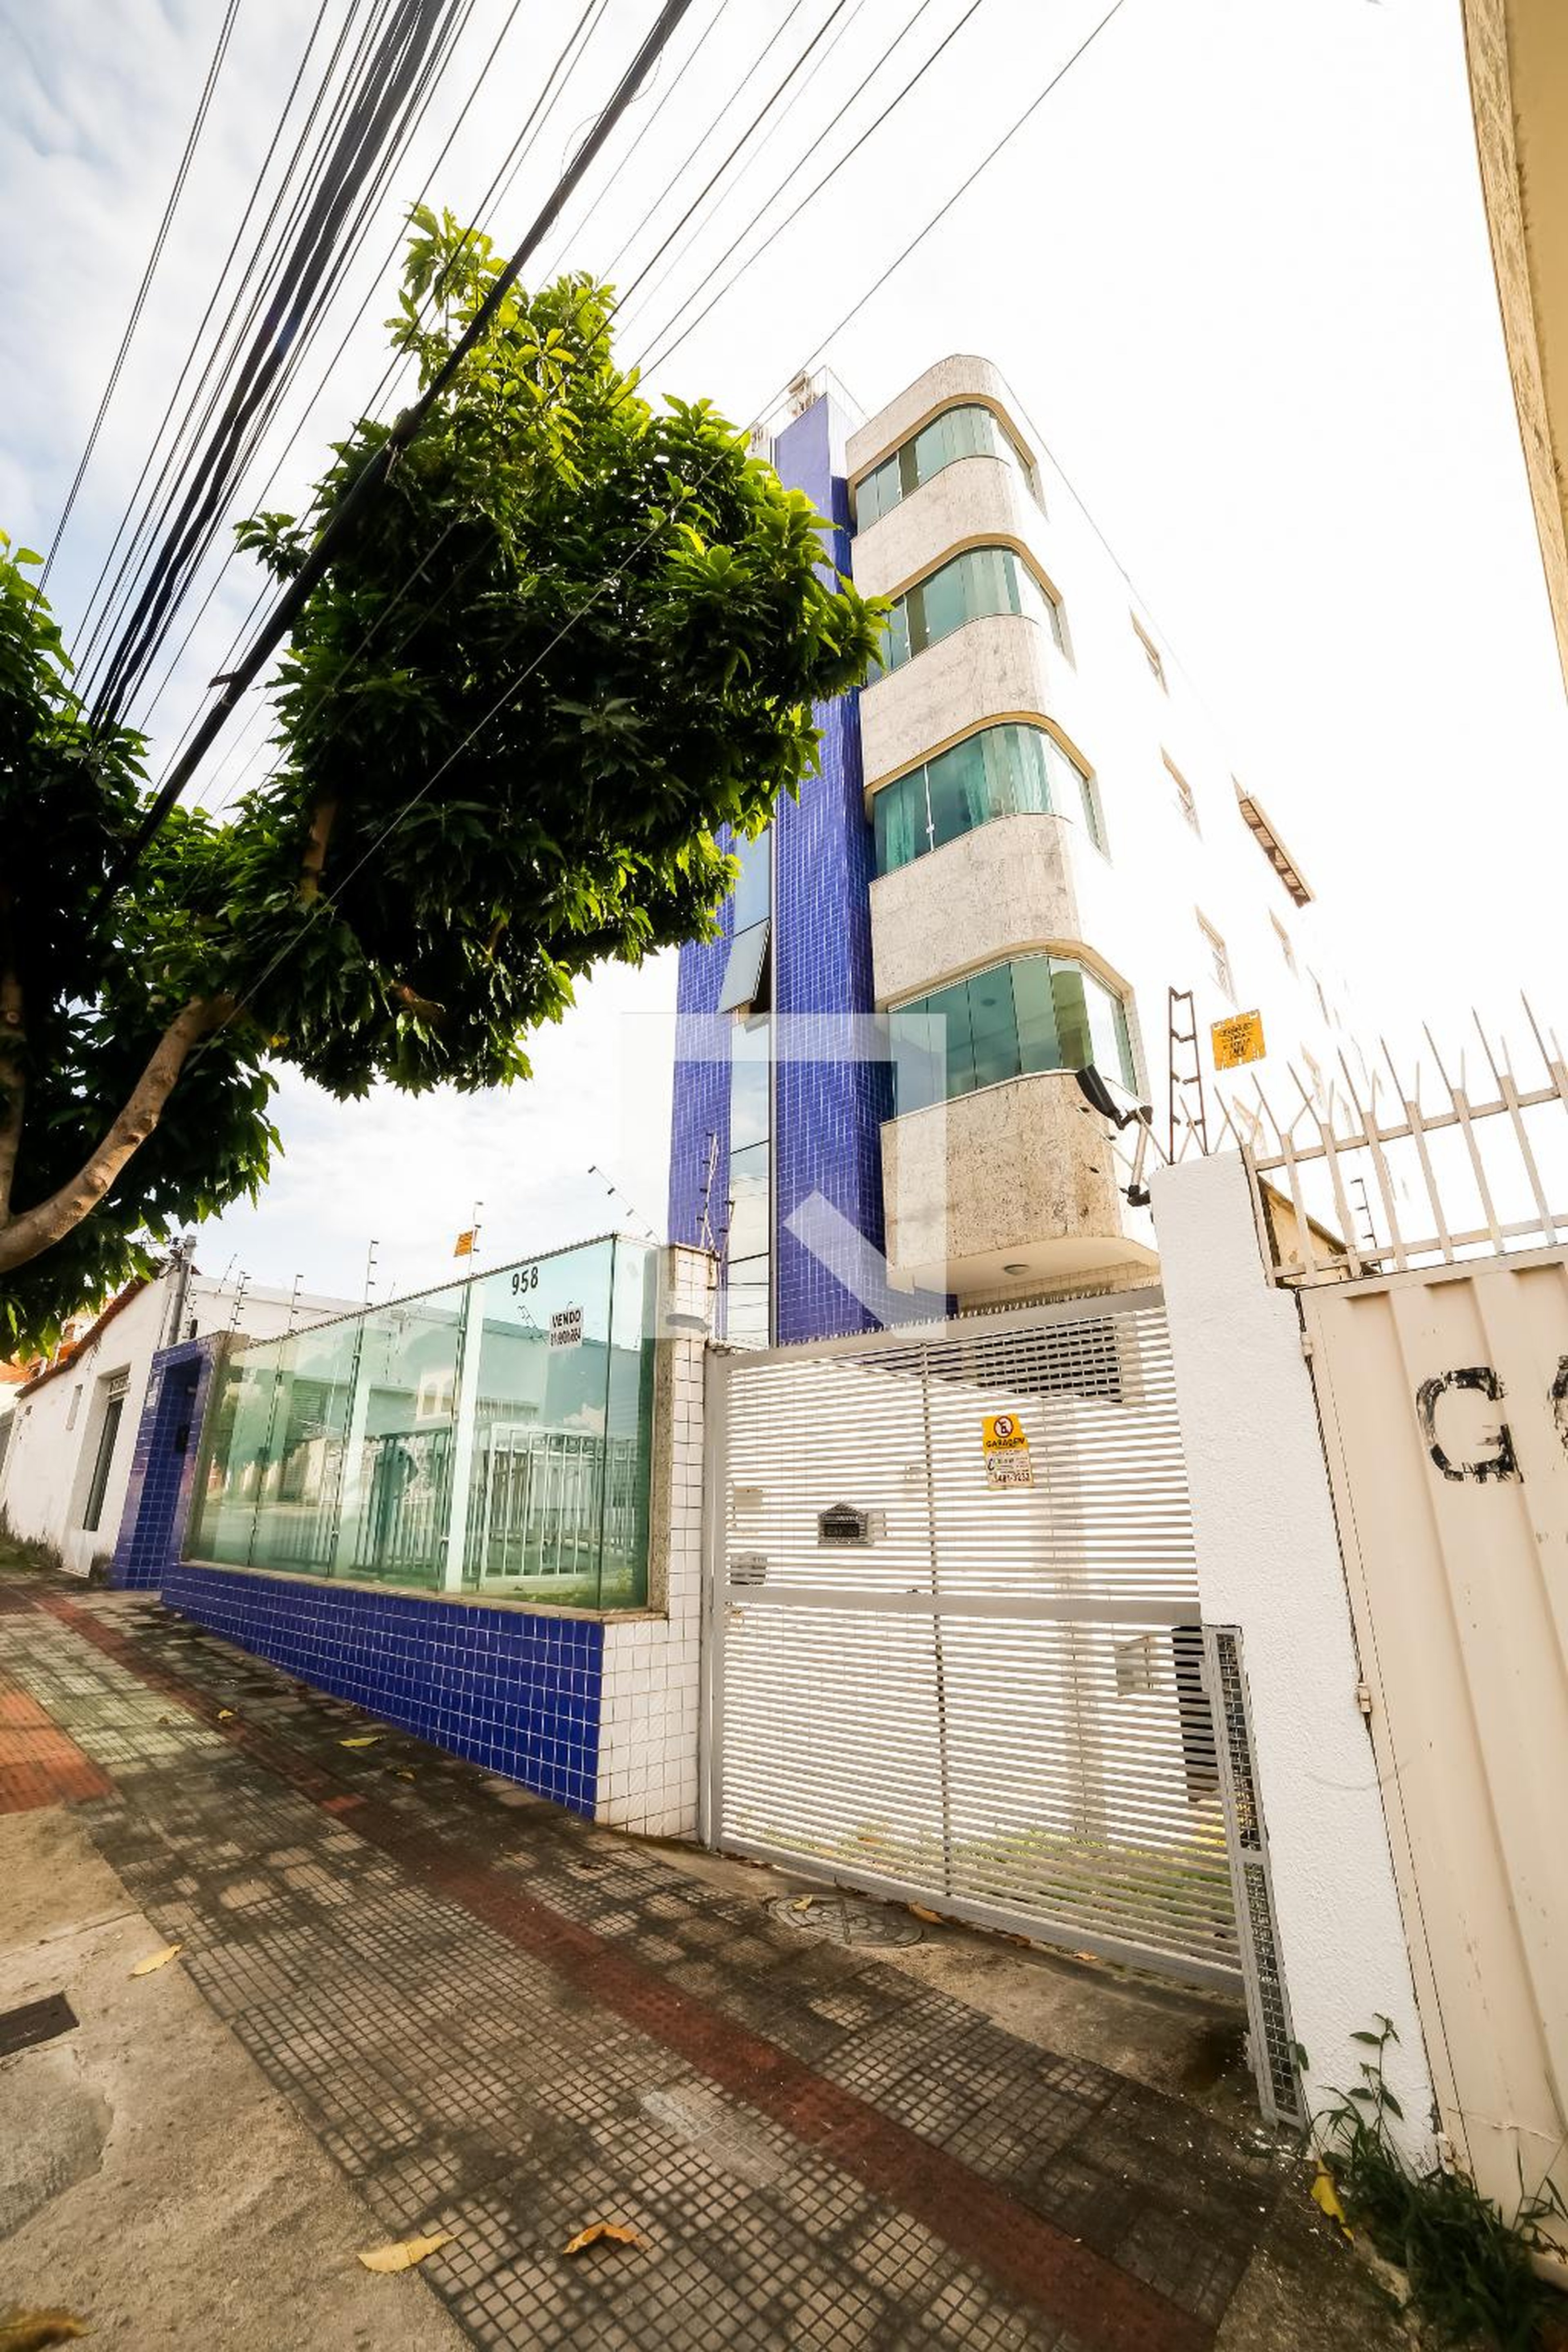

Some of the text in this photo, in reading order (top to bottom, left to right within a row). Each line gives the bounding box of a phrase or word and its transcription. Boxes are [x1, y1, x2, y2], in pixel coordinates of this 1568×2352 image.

[512, 1266, 538, 1295] 958
[552, 1310, 581, 1327] VENDO
[1416, 1355, 1568, 1484] G
